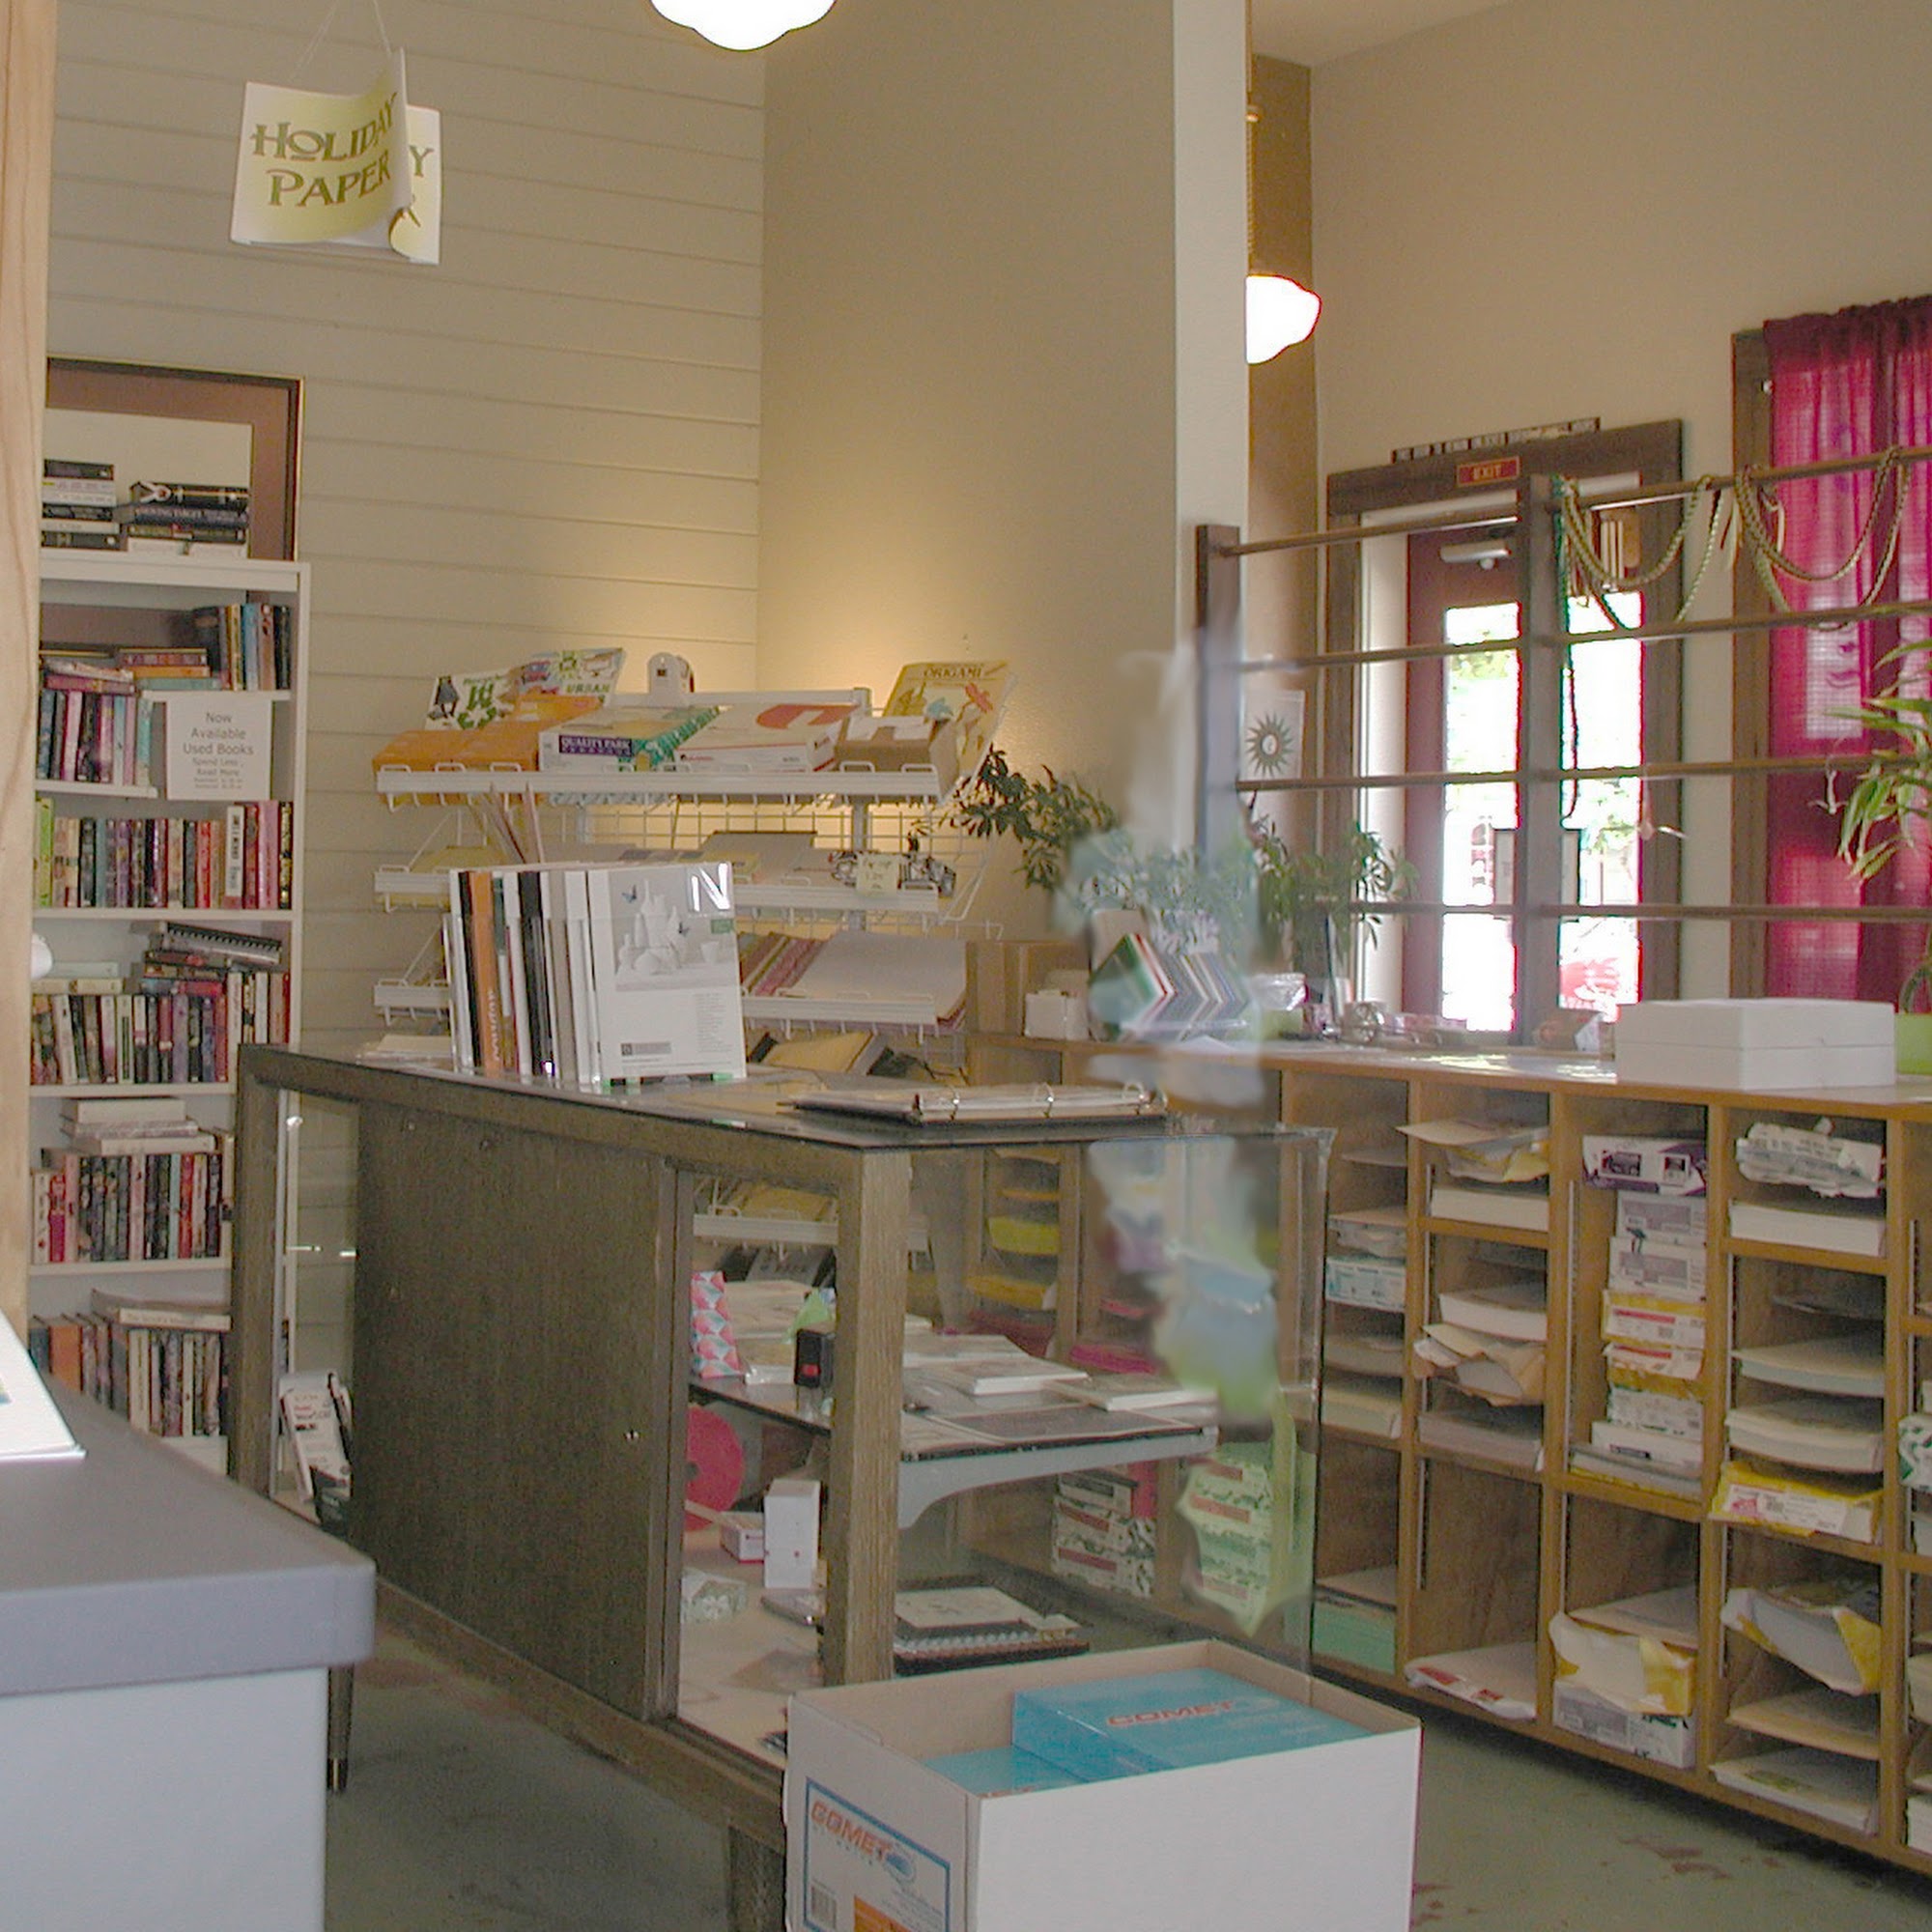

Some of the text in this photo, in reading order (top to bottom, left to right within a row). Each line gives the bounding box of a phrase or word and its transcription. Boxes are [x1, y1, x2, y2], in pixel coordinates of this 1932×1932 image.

[249, 92, 398, 161] HOLIDAY
[266, 149, 392, 207] PAPER
[1471, 464, 1503, 480] EXIT
[923, 666, 983, 679] ORIGAMI
[205, 712, 232, 724] Now
[190, 727, 246, 740] Available
[183, 743, 254, 755] Used Books
[1106, 1700, 1235, 1726] COMET
[810, 1801, 895, 1861] COMET
